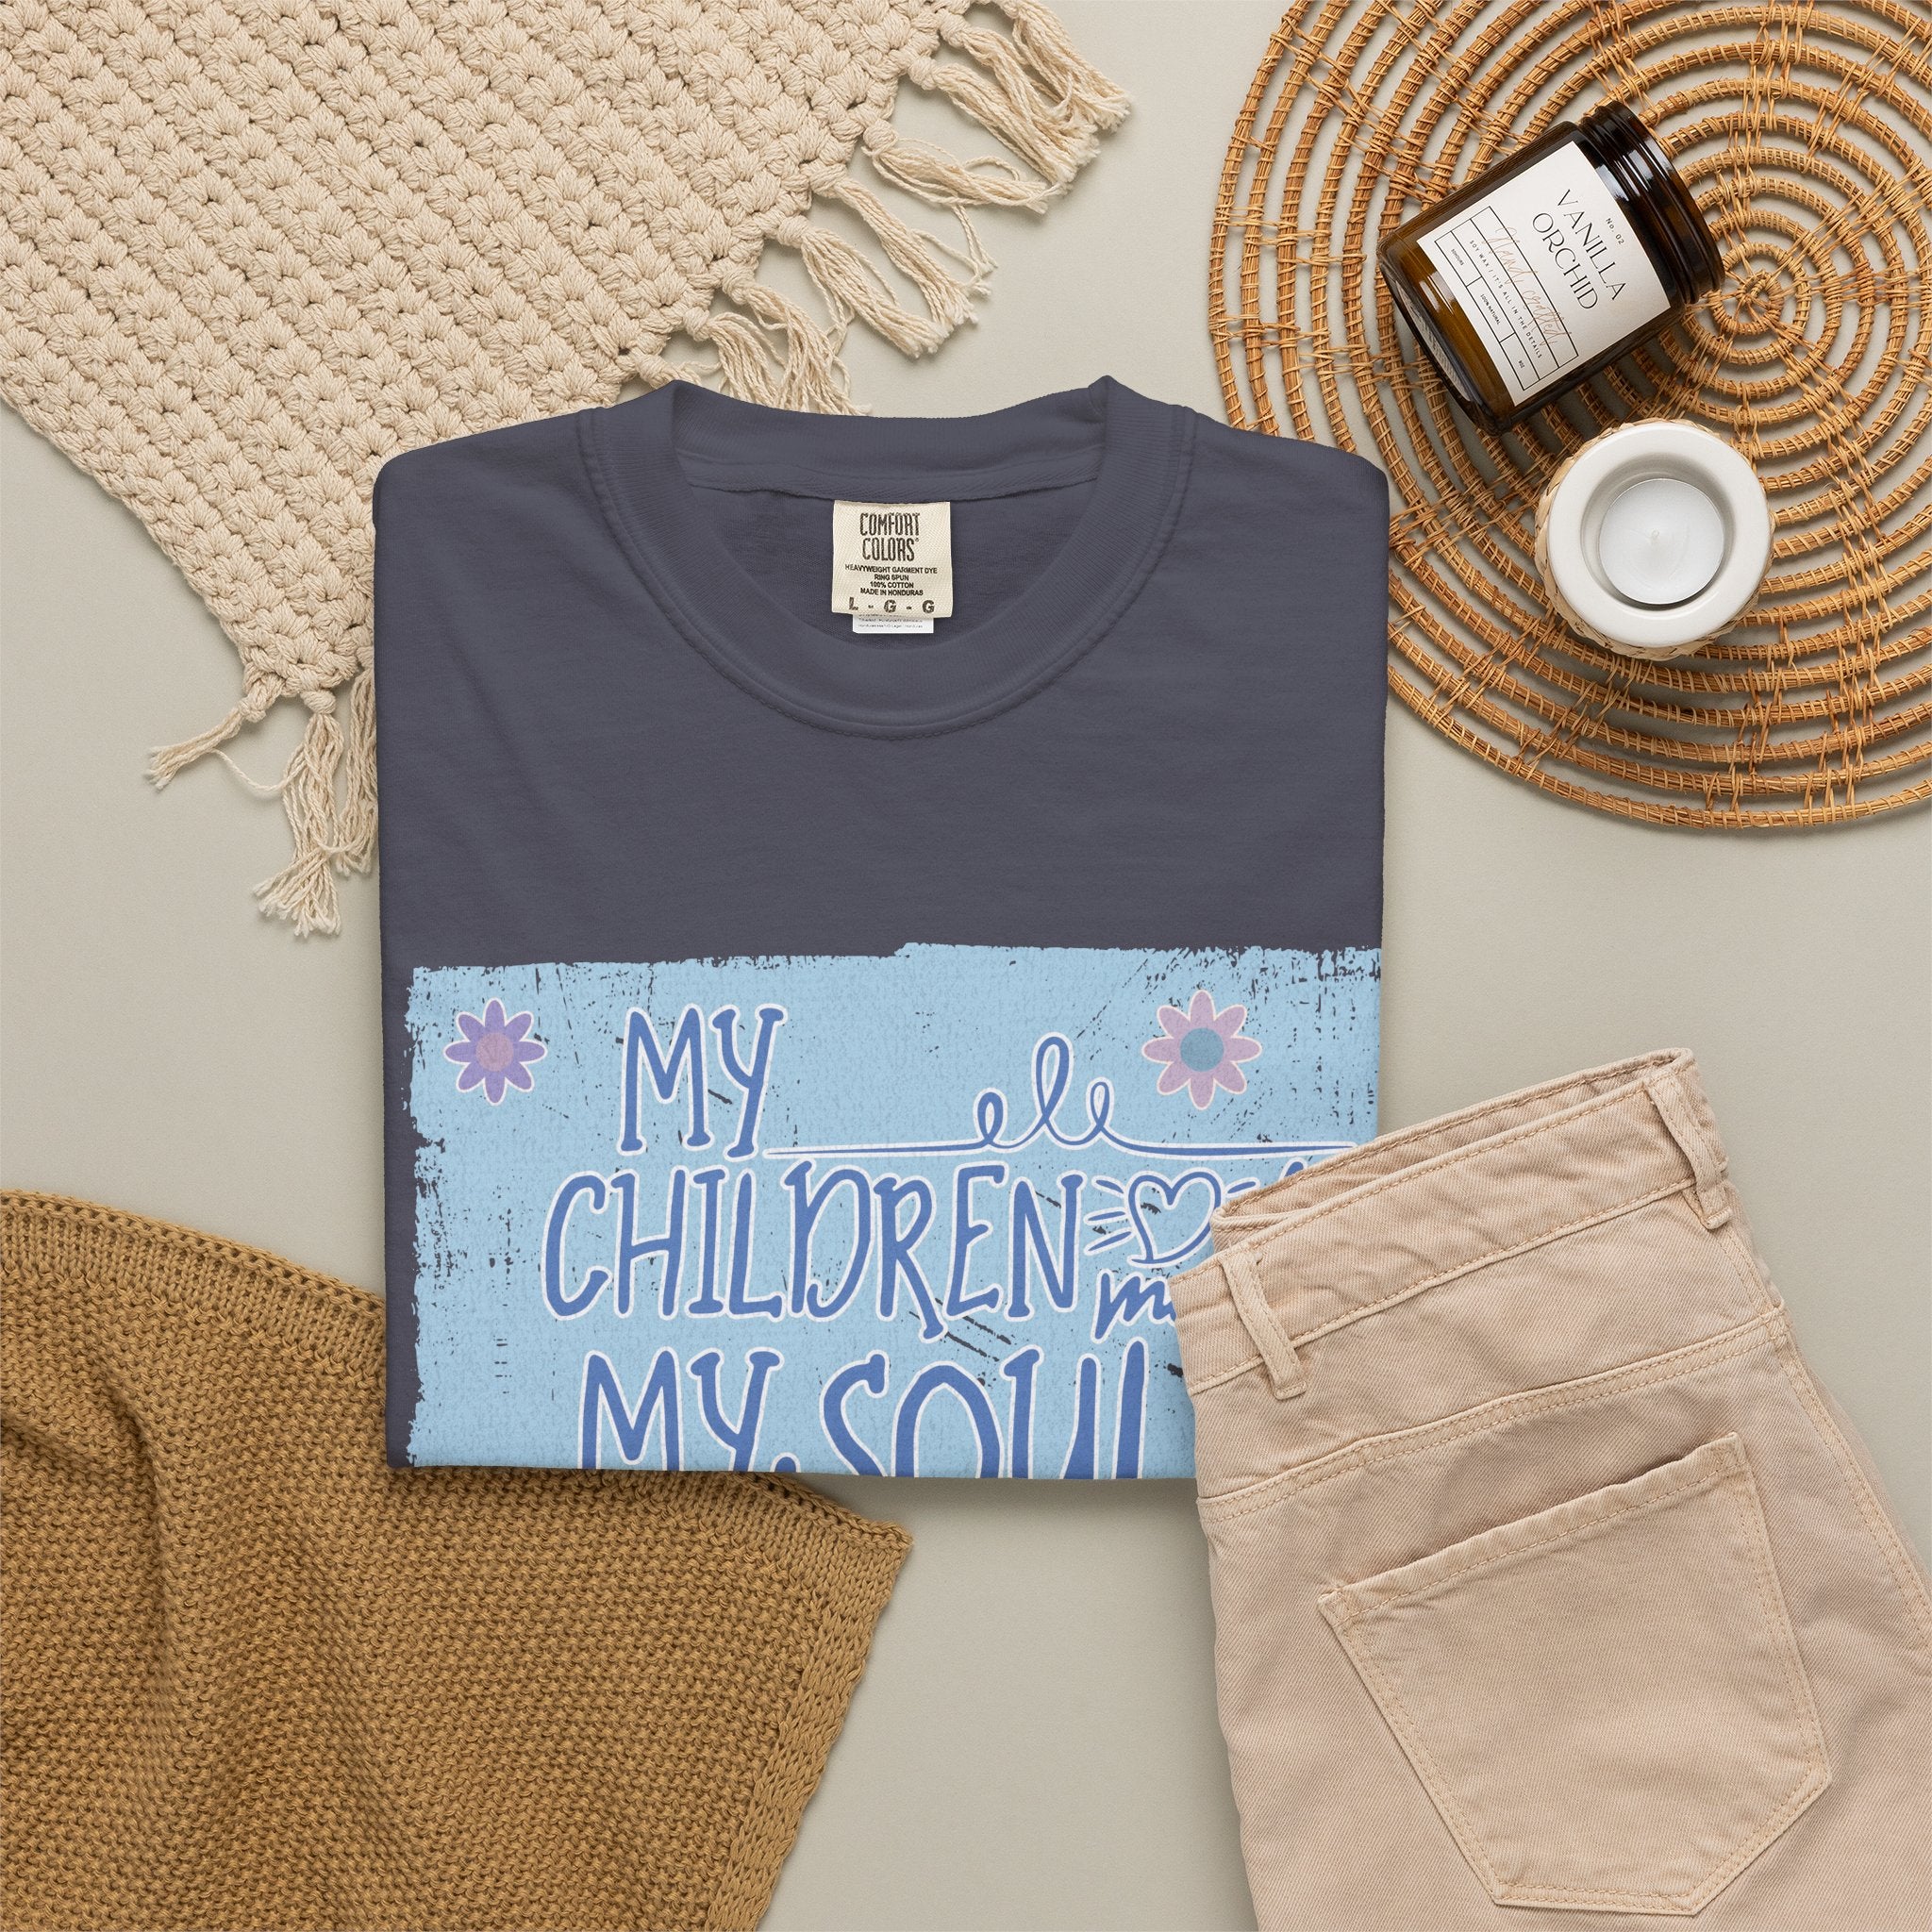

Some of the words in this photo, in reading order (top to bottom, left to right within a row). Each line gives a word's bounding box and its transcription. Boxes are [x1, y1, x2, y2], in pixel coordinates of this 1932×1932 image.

[1533, 213, 1597, 308] ORCHID
[1557, 190, 1625, 300] VANILLA
[1606, 217, 1616, 233] No.
[1615, 233, 1625, 245] 02
[1470, 241, 1479, 251] SOY
[1479, 254, 1489, 267] WAX
[1503, 291, 1511, 304] ALL
[1518, 317, 1527, 329] THE
[1526, 332, 1542, 358] DETAILS
[1489, 306, 1500, 325] NATURAL
[859, 512, 921, 536] COMFORT
[845, 564, 891, 574] HEAVYWEIGHT
[891, 566, 924, 575] GARMENT
[860, 588, 879, 596] MADE
[849, 597, 858, 610] L
[884, 599, 897, 613] G
[922, 599, 935, 613] G
[621, 1005, 786, 1160] MY
[541, 1158, 1090, 1341] CHILDREN
[577, 1346, 785, 1473] MY
